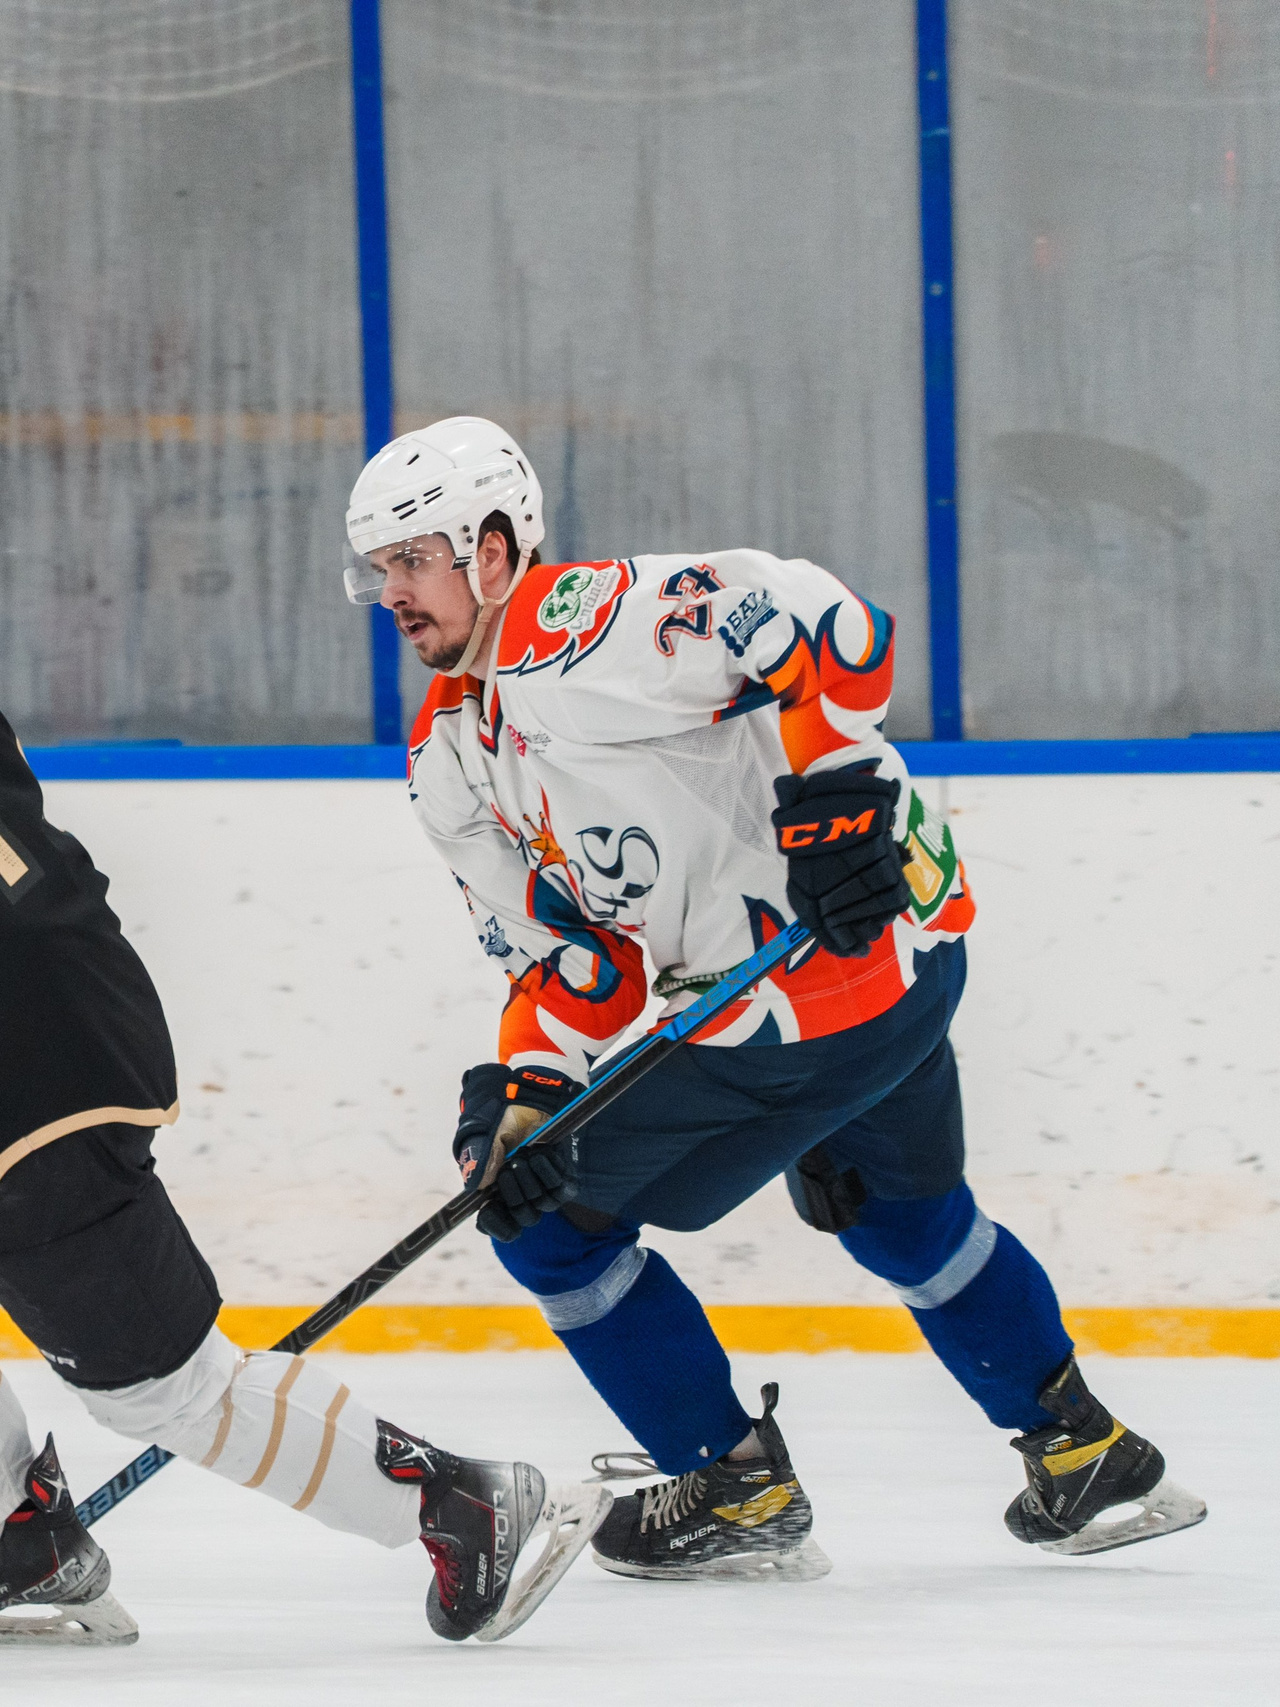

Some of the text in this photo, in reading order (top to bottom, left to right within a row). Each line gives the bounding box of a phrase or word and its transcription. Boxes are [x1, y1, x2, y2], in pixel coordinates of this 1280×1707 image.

[681, 936, 787, 1028] NEXUS
[522, 1071, 563, 1087] CCM
[1051, 1494, 1067, 1517] AUER
[670, 1523, 717, 1550] BAUER
[477, 1552, 488, 1596] BAUER
